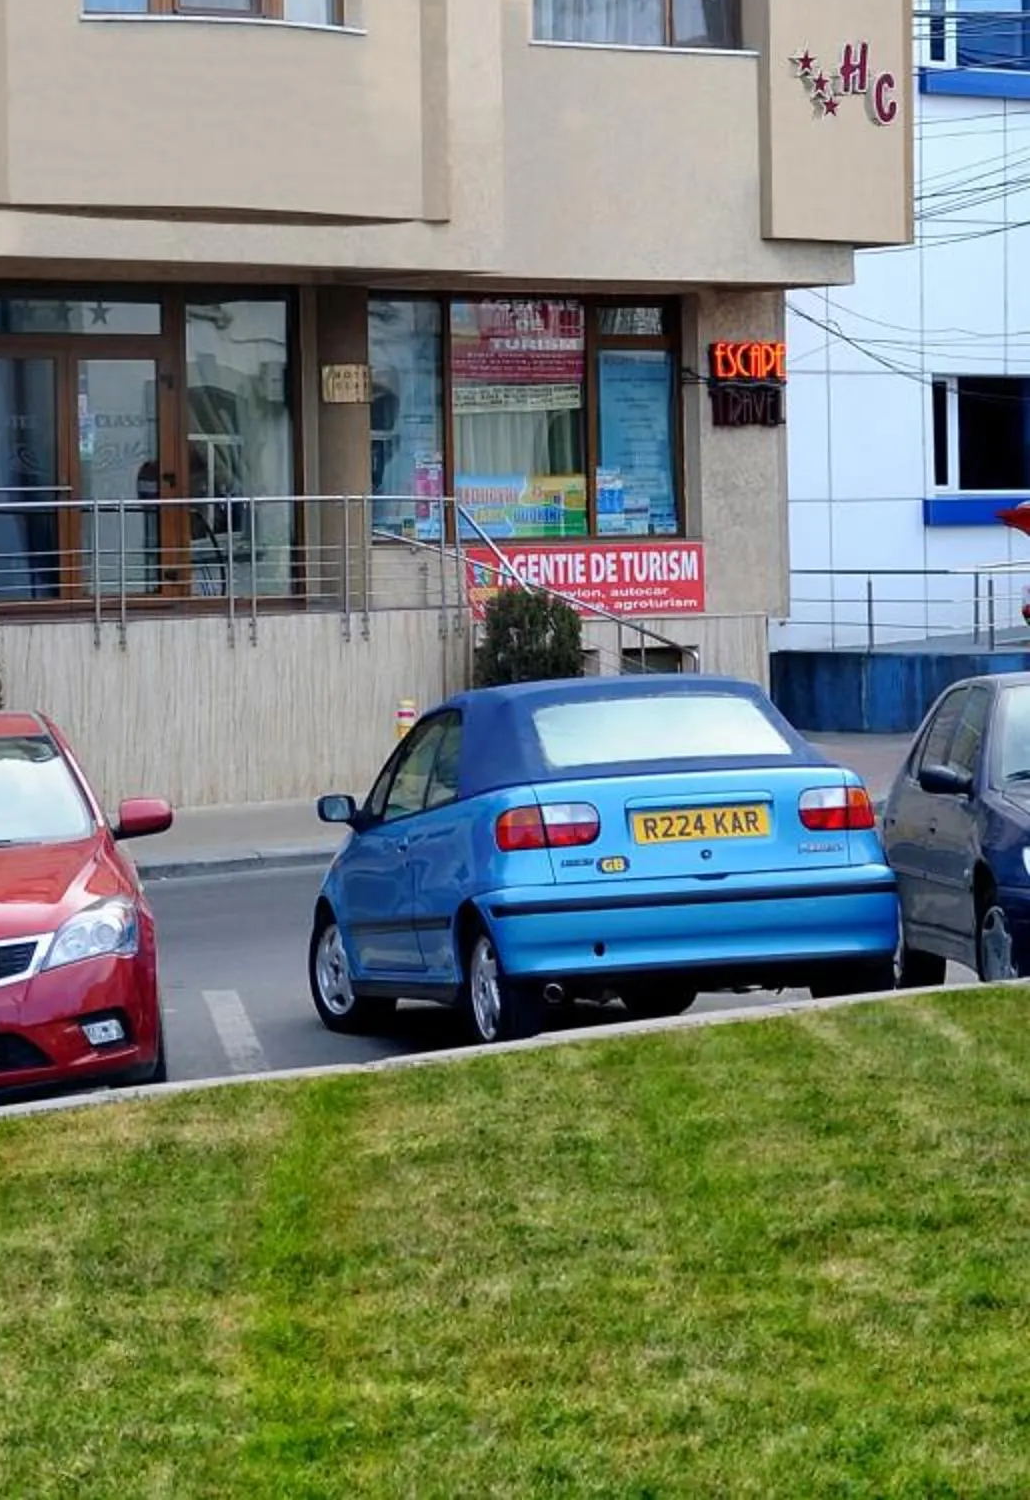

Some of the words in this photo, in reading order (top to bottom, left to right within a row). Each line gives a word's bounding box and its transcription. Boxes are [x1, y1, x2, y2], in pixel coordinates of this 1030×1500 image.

[714, 342, 787, 378] ESCAPE
[590, 553, 620, 583] DE
[620, 550, 699, 582] TURISM
[609, 586, 670, 598] autocar
[613, 599, 699, 611] agroturism
[643, 814, 708, 840] R224
[712, 810, 760, 834] KAR
[601, 857, 626, 873] GB
